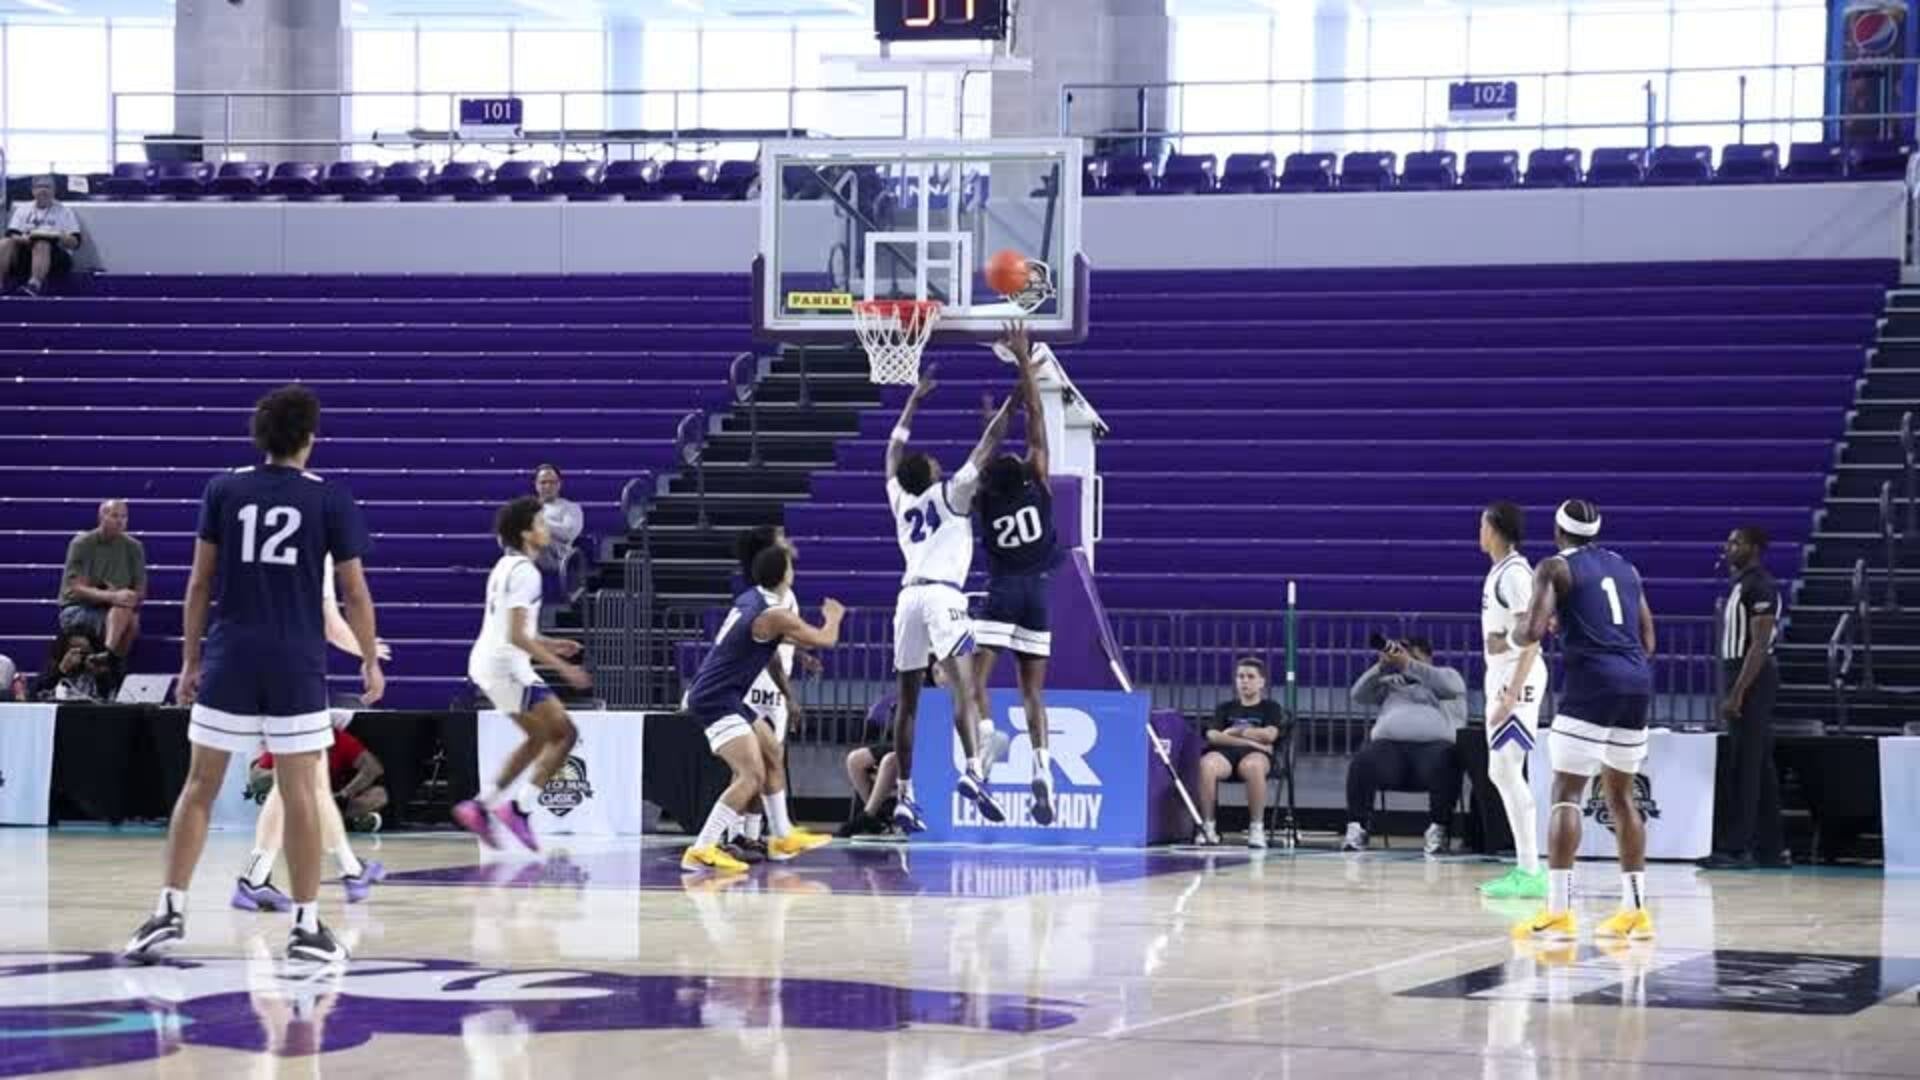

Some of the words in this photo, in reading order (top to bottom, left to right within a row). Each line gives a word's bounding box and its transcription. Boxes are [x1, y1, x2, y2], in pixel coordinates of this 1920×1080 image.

[1474, 85, 1507, 104] 102
[484, 102, 511, 120] 101
[792, 295, 848, 305] PANINI
[237, 503, 302, 565] 12
[992, 505, 1043, 548] 20
[1600, 576, 1624, 625] 1
